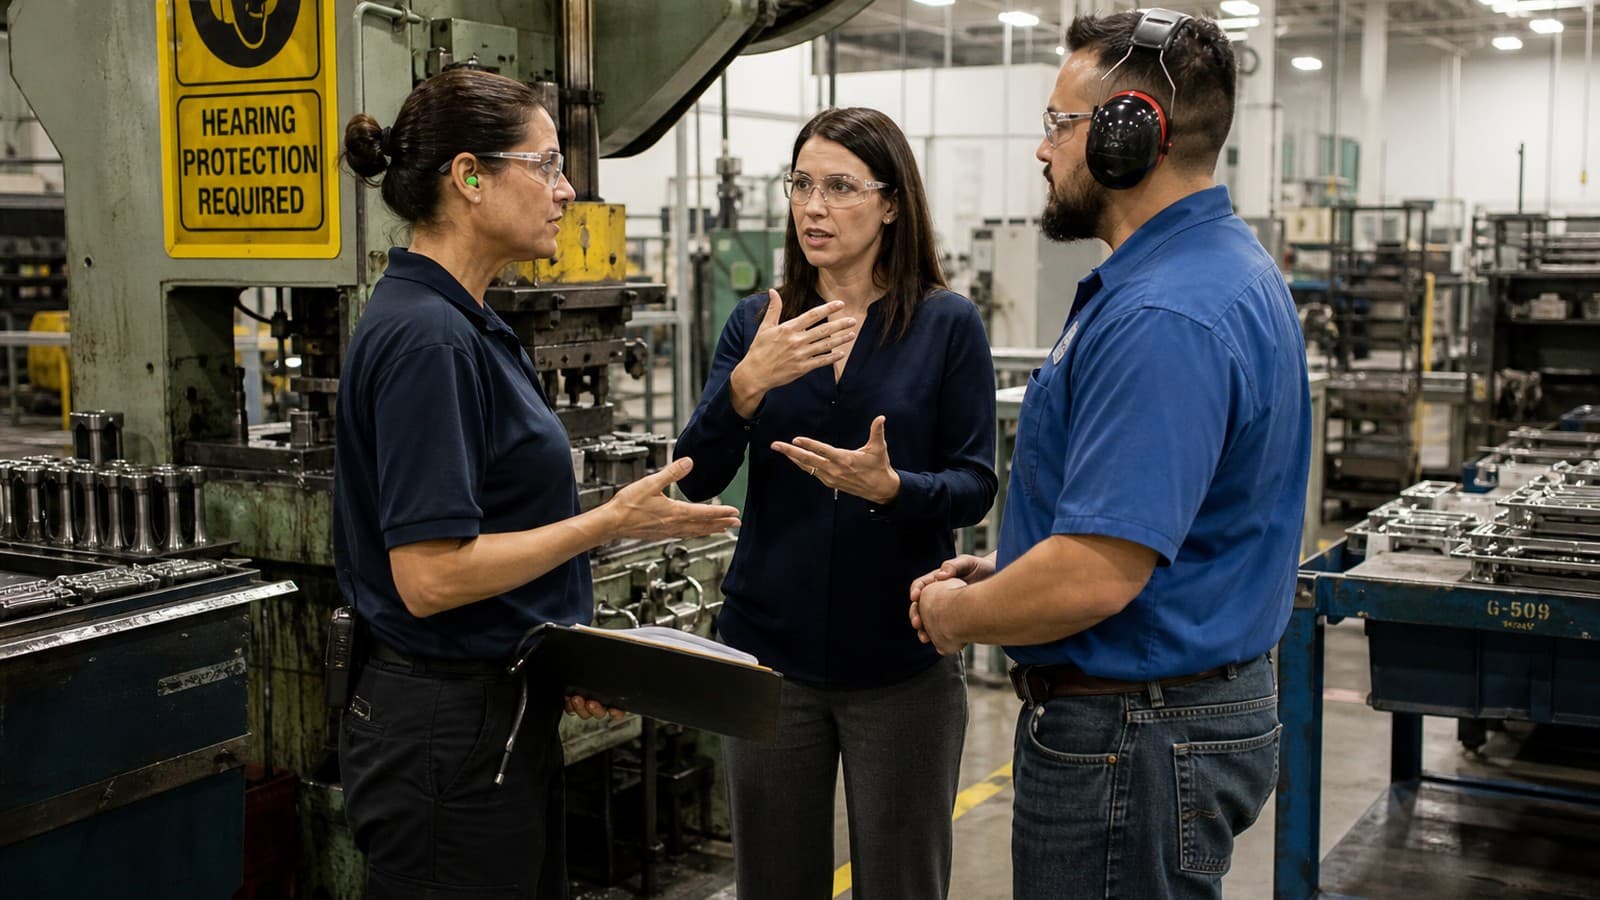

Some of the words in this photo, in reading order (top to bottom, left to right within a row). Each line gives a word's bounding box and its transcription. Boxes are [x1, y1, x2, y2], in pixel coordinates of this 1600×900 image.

[202, 105, 296, 136] HEARING
[183, 145, 318, 176] PROTECTION
[198, 186, 304, 216] REQUIRED
[1487, 600, 1550, 620] G-509
